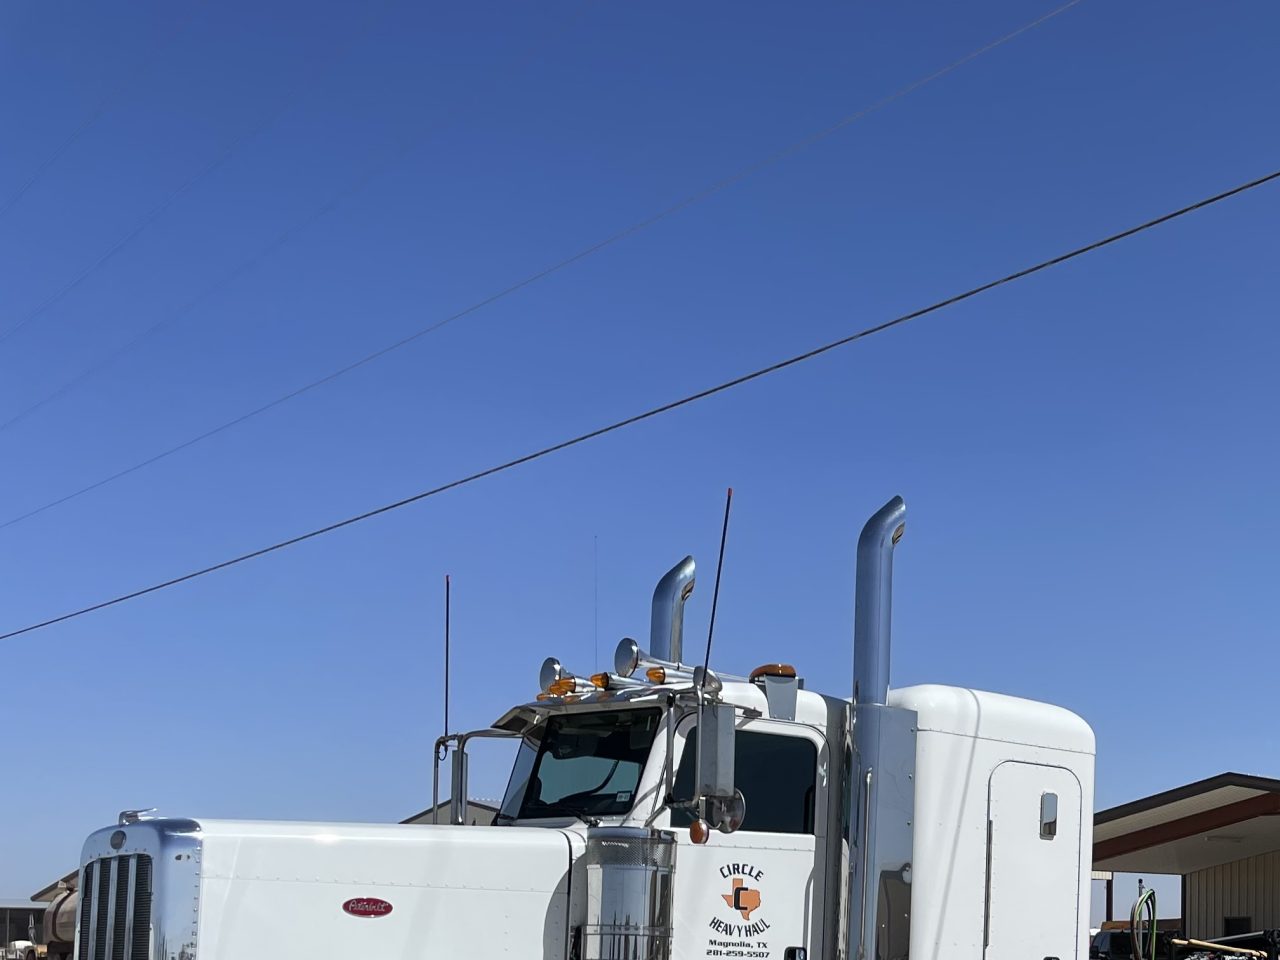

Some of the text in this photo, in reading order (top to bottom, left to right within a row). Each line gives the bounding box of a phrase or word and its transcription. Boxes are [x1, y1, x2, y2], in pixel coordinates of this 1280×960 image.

[719, 863, 764, 882] CIRCLE
[348, 899, 389, 912] Peterbilt
[734, 887, 749, 910] C
[709, 916, 771, 938] HEAVY HAUL
[708, 939, 768, 949] Magnolia, TX
[706, 949, 770, 959] 281-259-5507
